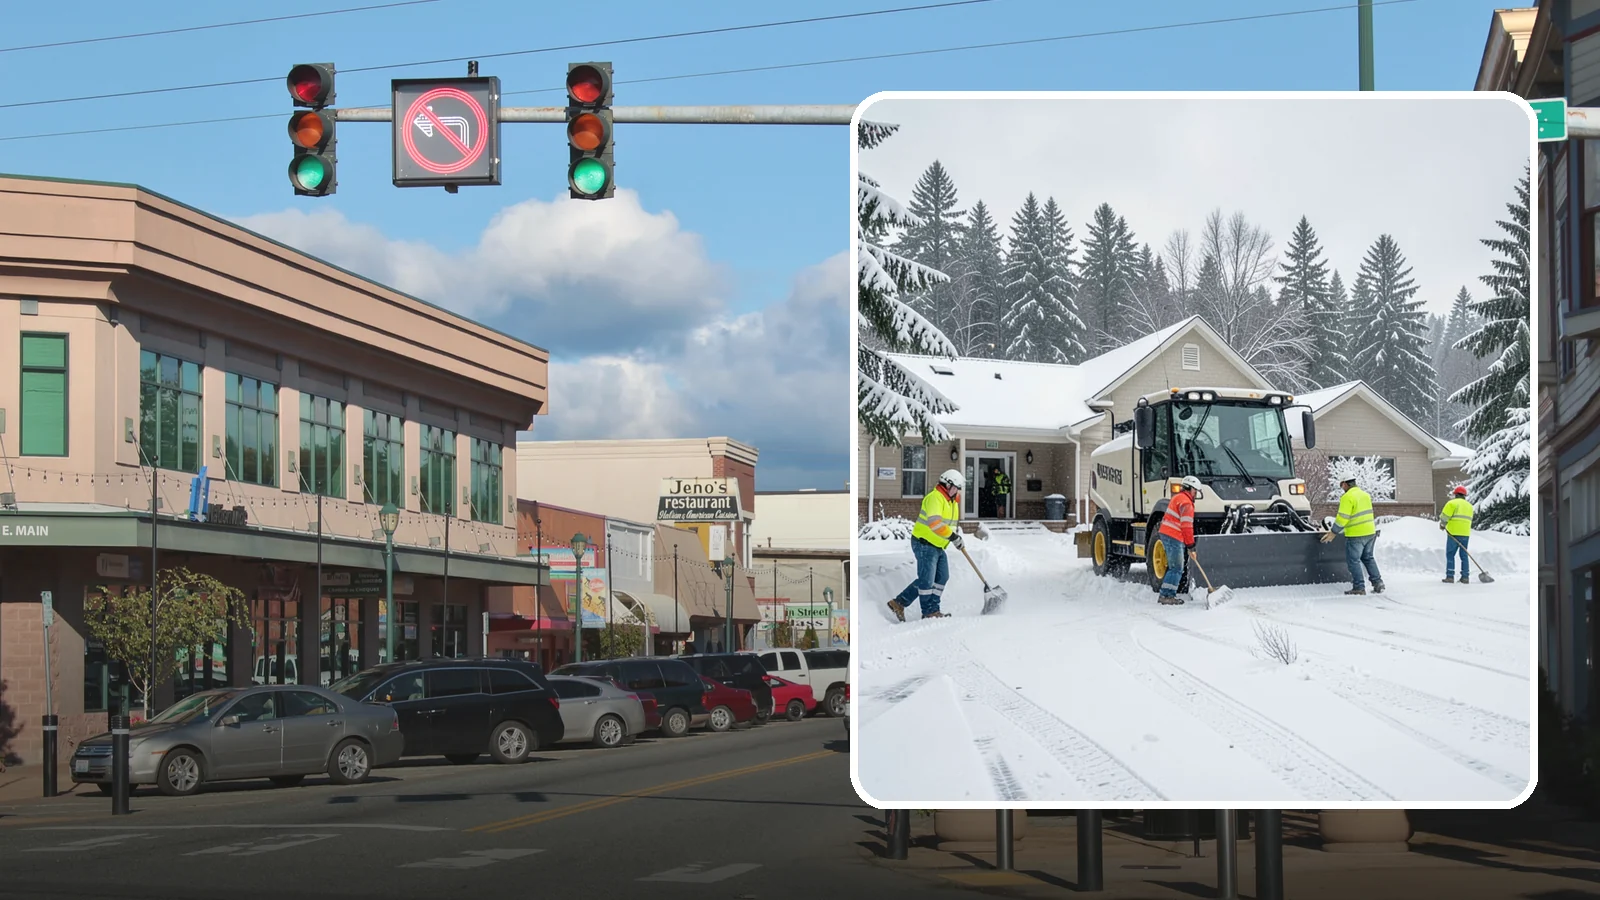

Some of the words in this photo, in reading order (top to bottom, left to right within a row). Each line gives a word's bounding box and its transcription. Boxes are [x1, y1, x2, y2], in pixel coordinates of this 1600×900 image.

[669, 480, 727, 494] Jeno's
[665, 496, 731, 509] restaurant
[658, 510, 681, 520] Italian
[686, 509, 714, 519] American
[715, 509, 738, 519] Cuisine
[2, 525, 13, 536] E.
[15, 525, 49, 536] MAIN
[797, 607, 828, 617] Street
